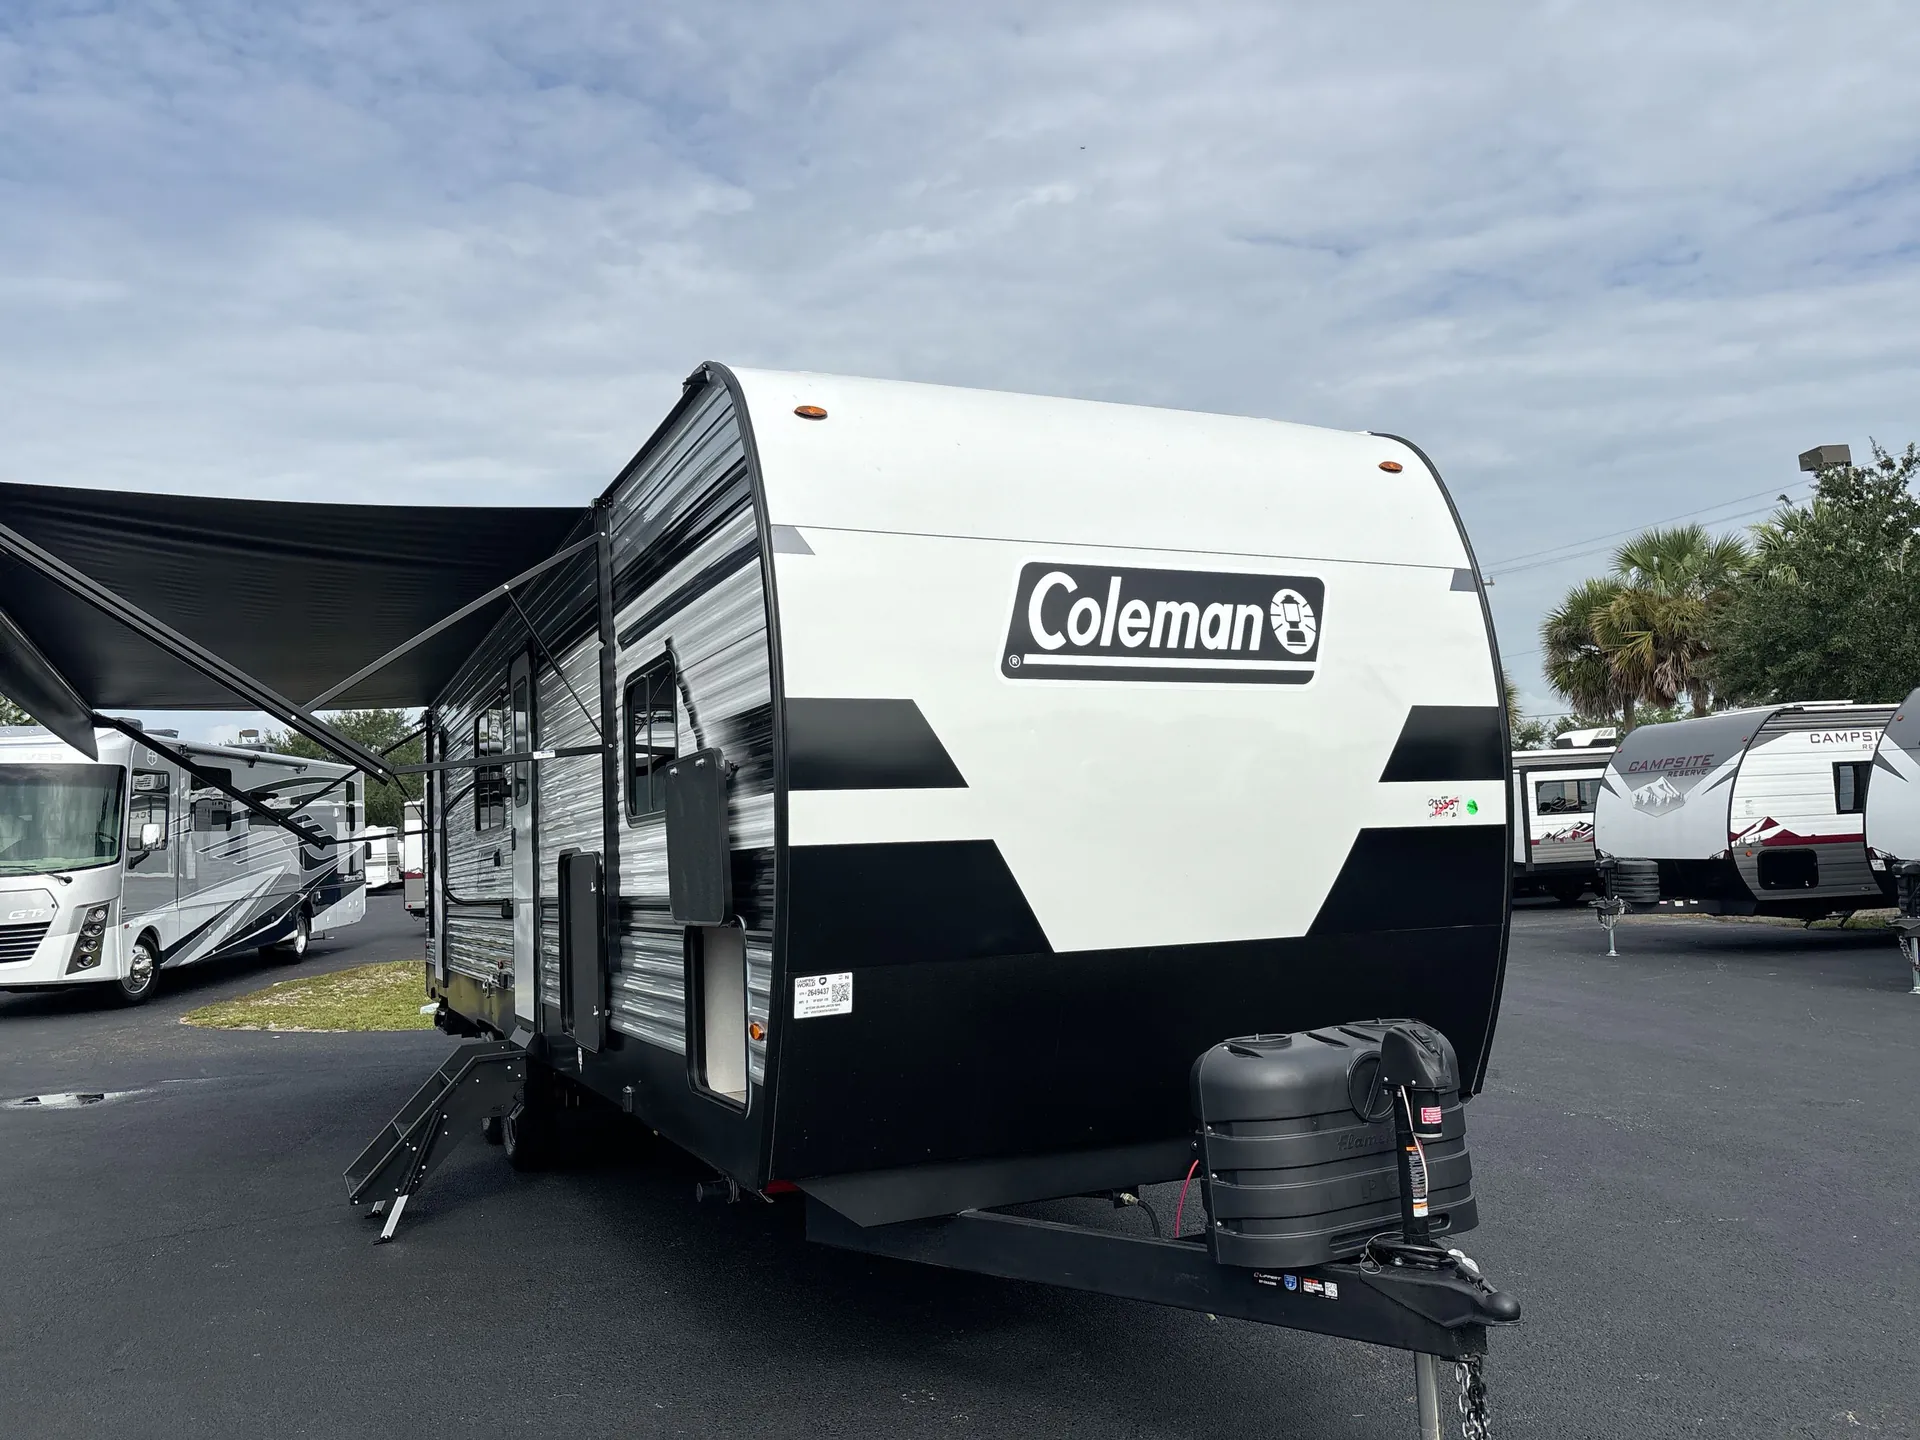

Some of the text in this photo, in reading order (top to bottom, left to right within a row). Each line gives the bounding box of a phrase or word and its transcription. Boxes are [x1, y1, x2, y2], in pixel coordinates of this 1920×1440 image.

[1028, 571, 1264, 650] Coleman
[1628, 754, 1714, 772] CAMPSITE
[1667, 768, 1708, 777] RESERVE
